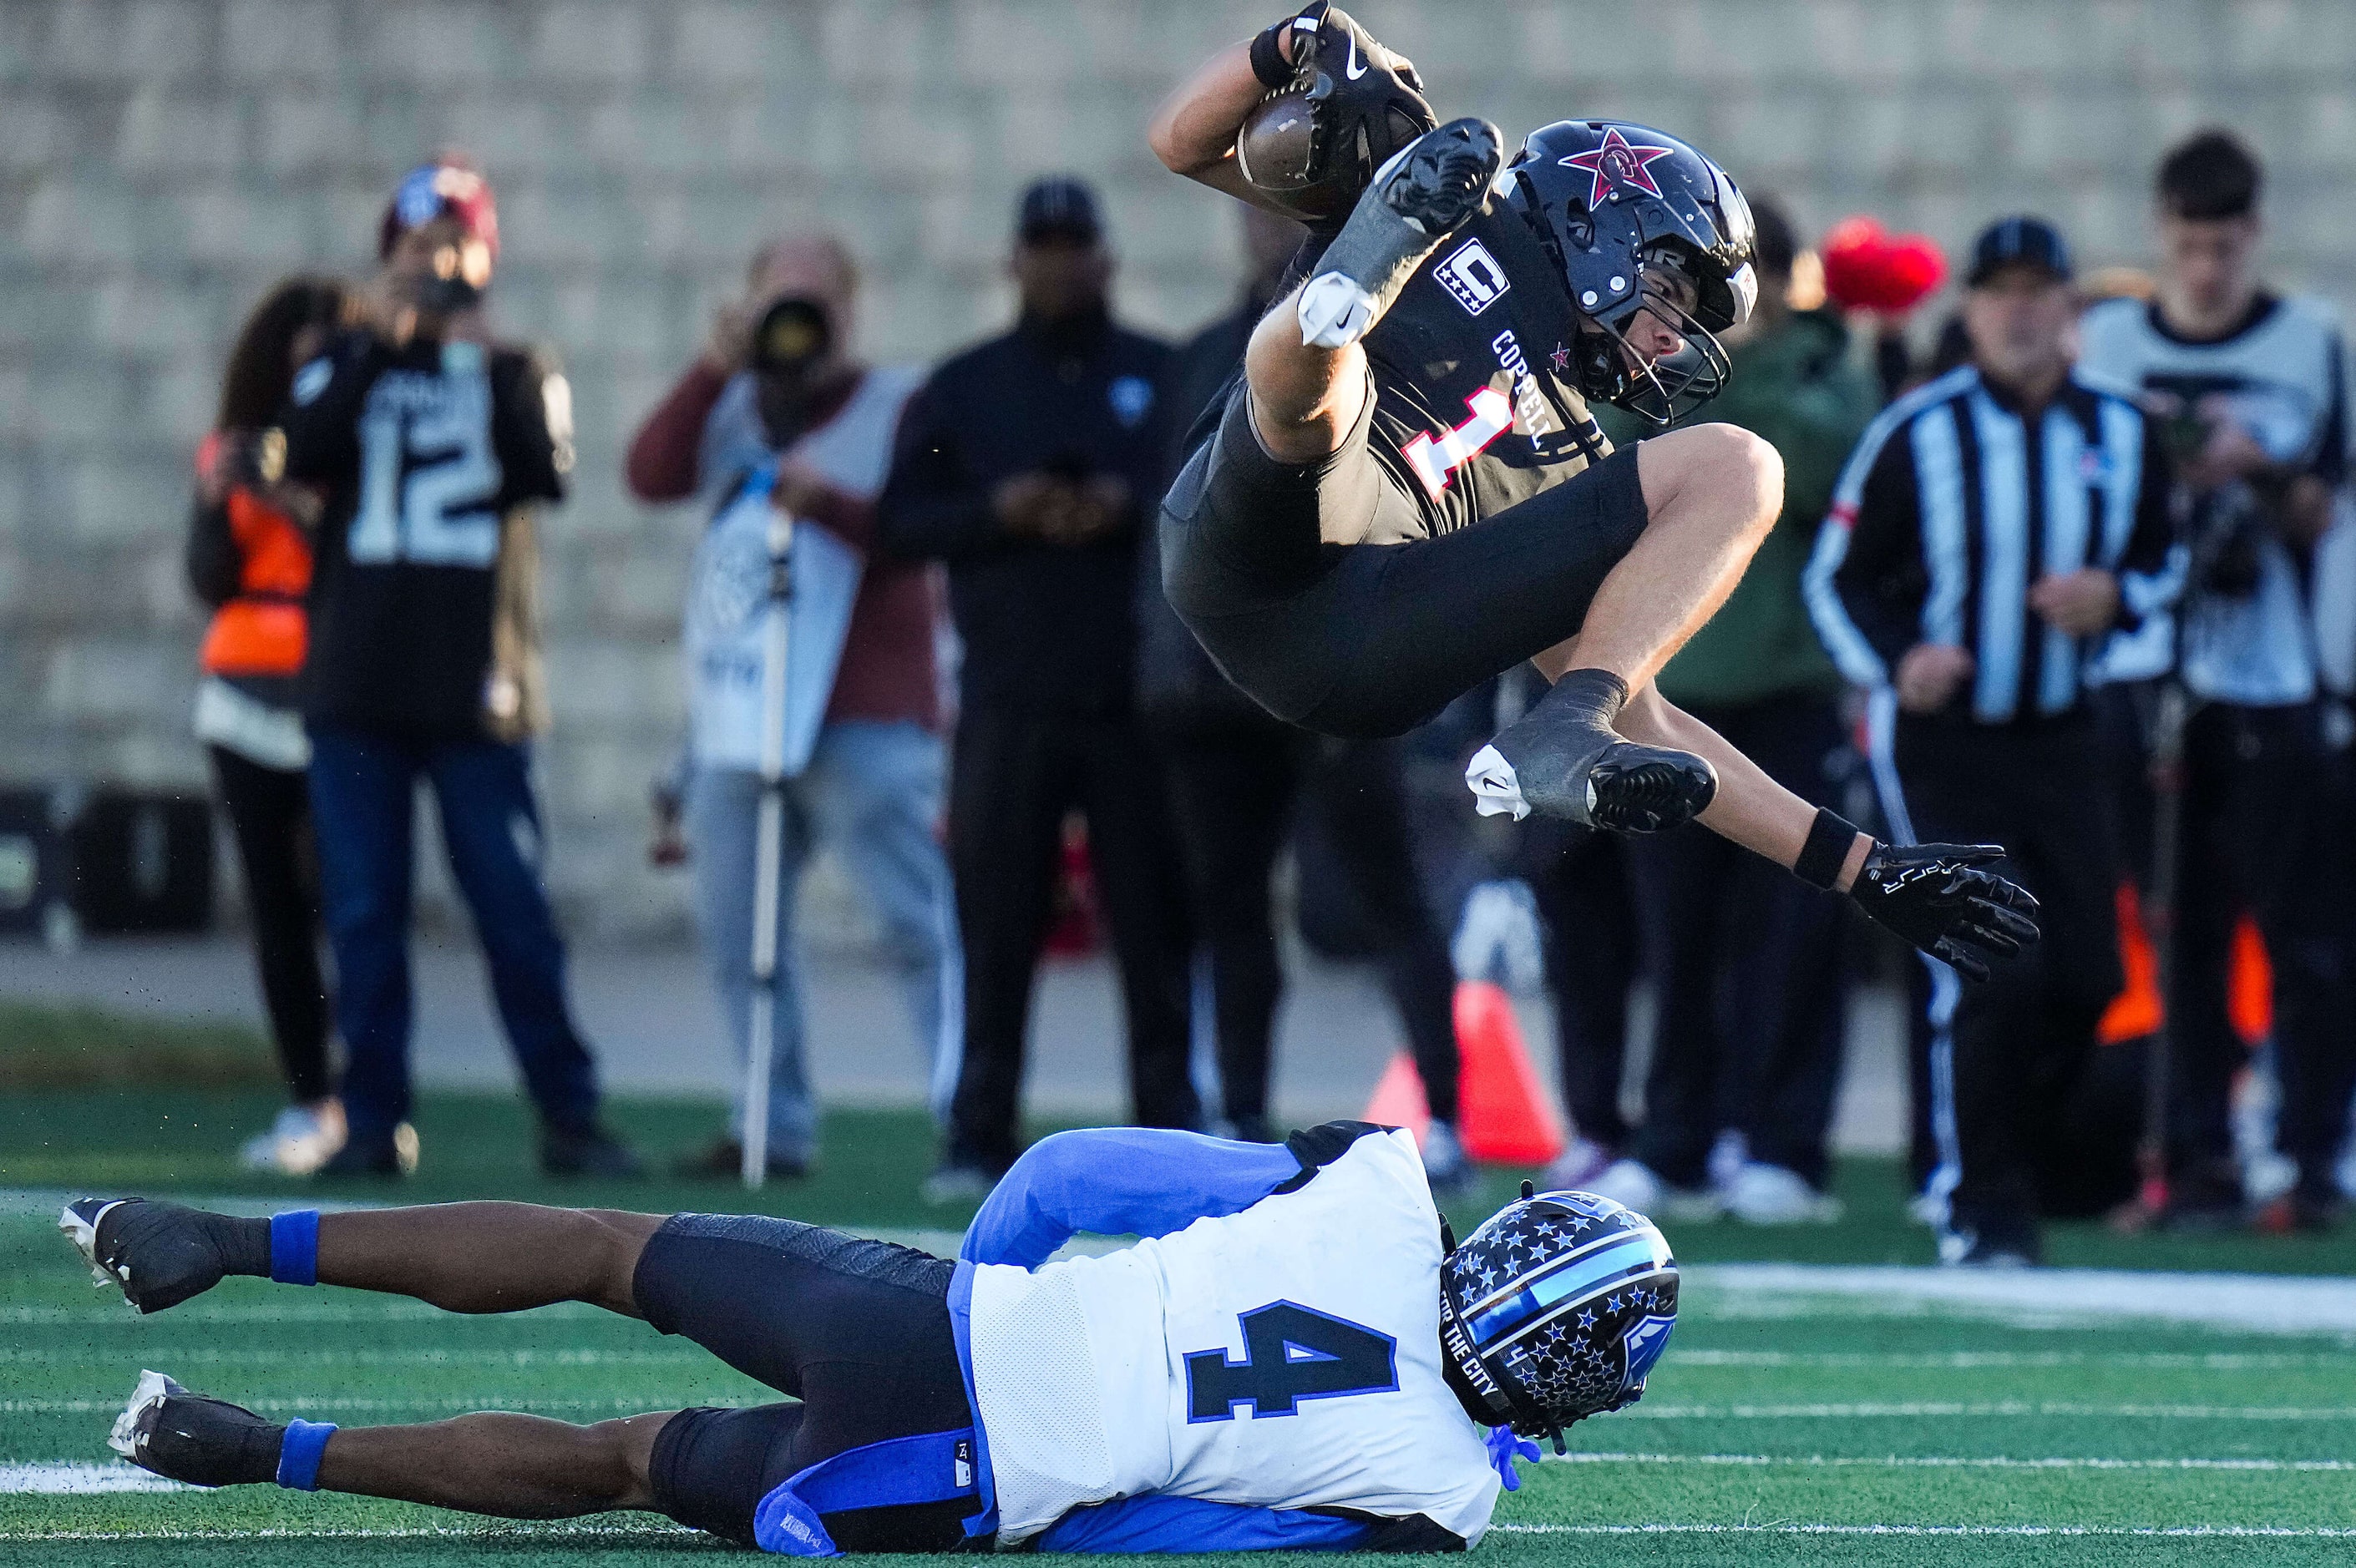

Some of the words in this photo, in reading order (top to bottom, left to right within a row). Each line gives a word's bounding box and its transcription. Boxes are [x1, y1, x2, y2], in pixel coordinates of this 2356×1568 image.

[1451, 244, 1506, 302] C
[1401, 385, 1517, 503] 1
[1492, 329, 1543, 450] COPPELL
[347, 407, 503, 568] 12
[1183, 1298, 1401, 1424] 4
[1444, 1323, 1472, 1362] THE
[1462, 1357, 1499, 1397] CITY
[1506, 1346, 1529, 1368] 4
